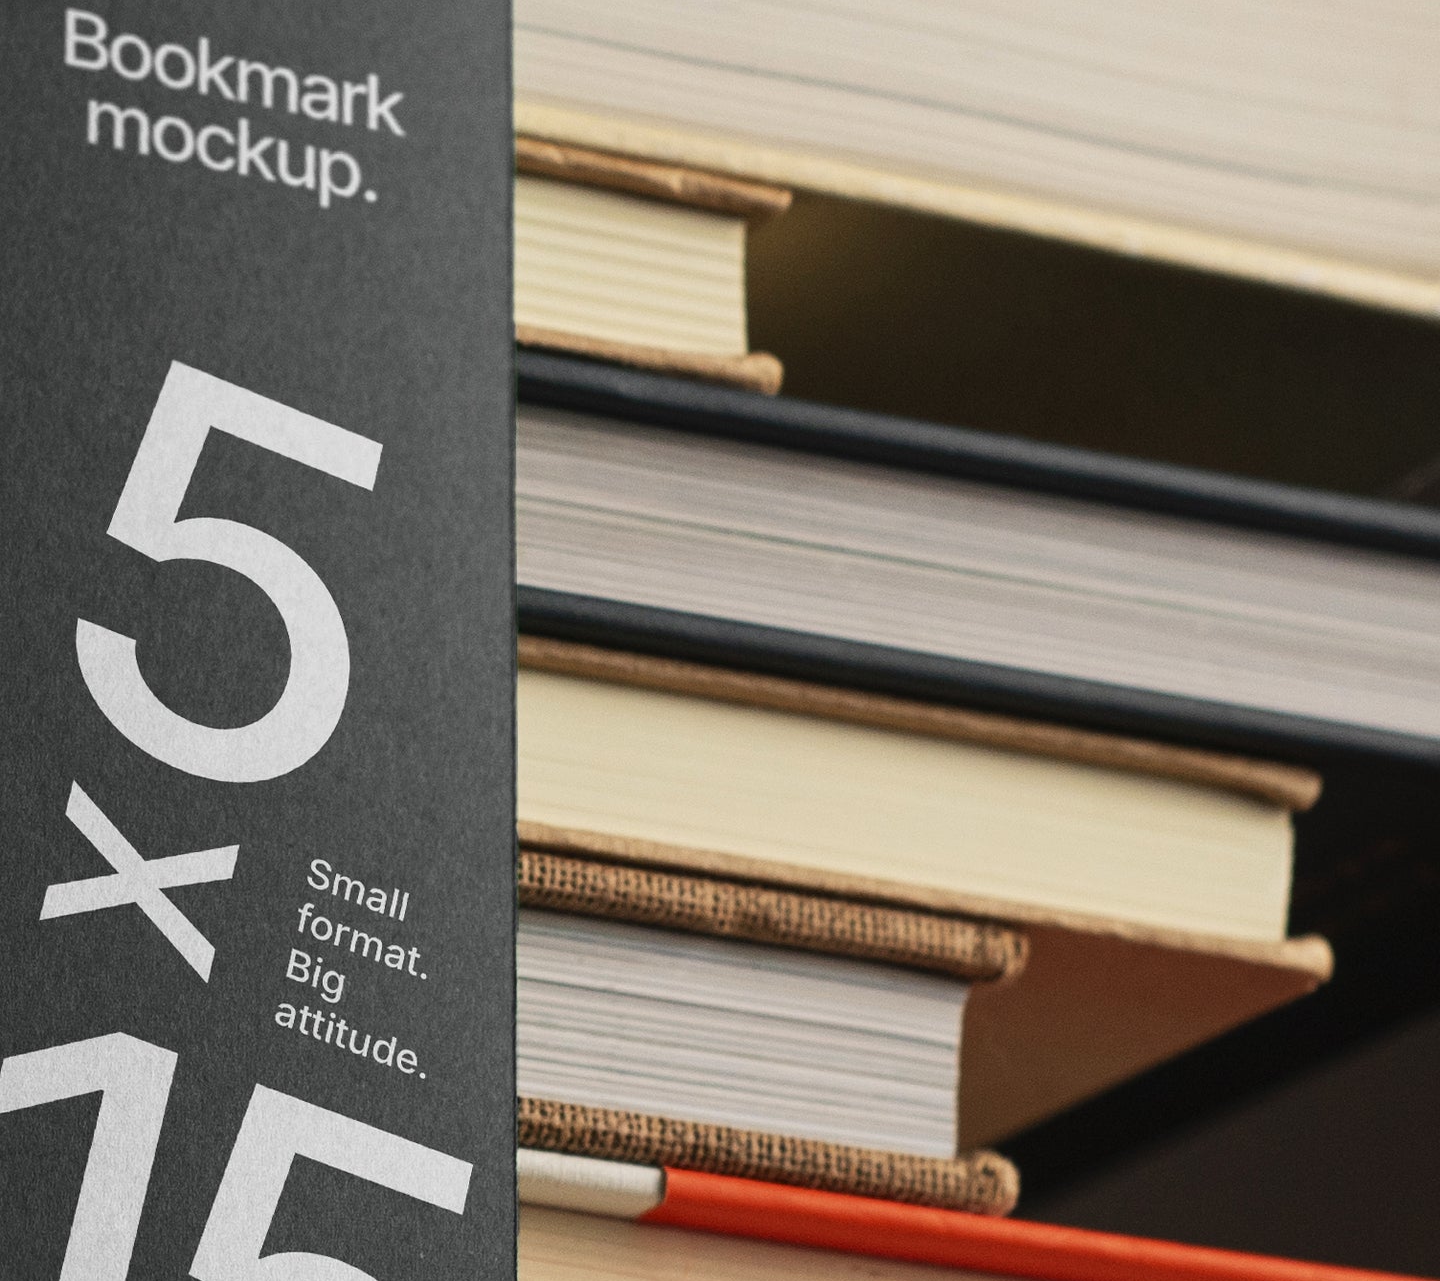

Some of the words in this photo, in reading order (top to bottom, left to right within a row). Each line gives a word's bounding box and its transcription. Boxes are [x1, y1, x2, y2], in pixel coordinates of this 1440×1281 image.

[63, 6, 408, 138] Bookmark
[86, 99, 380, 210] mockup.
[74, 359, 385, 784] 5
[39, 780, 241, 983] x
[305, 857, 411, 923] Small
[285, 947, 347, 1005] Big
[296, 902, 430, 979] format.
[273, 998, 428, 1080] attitude.
